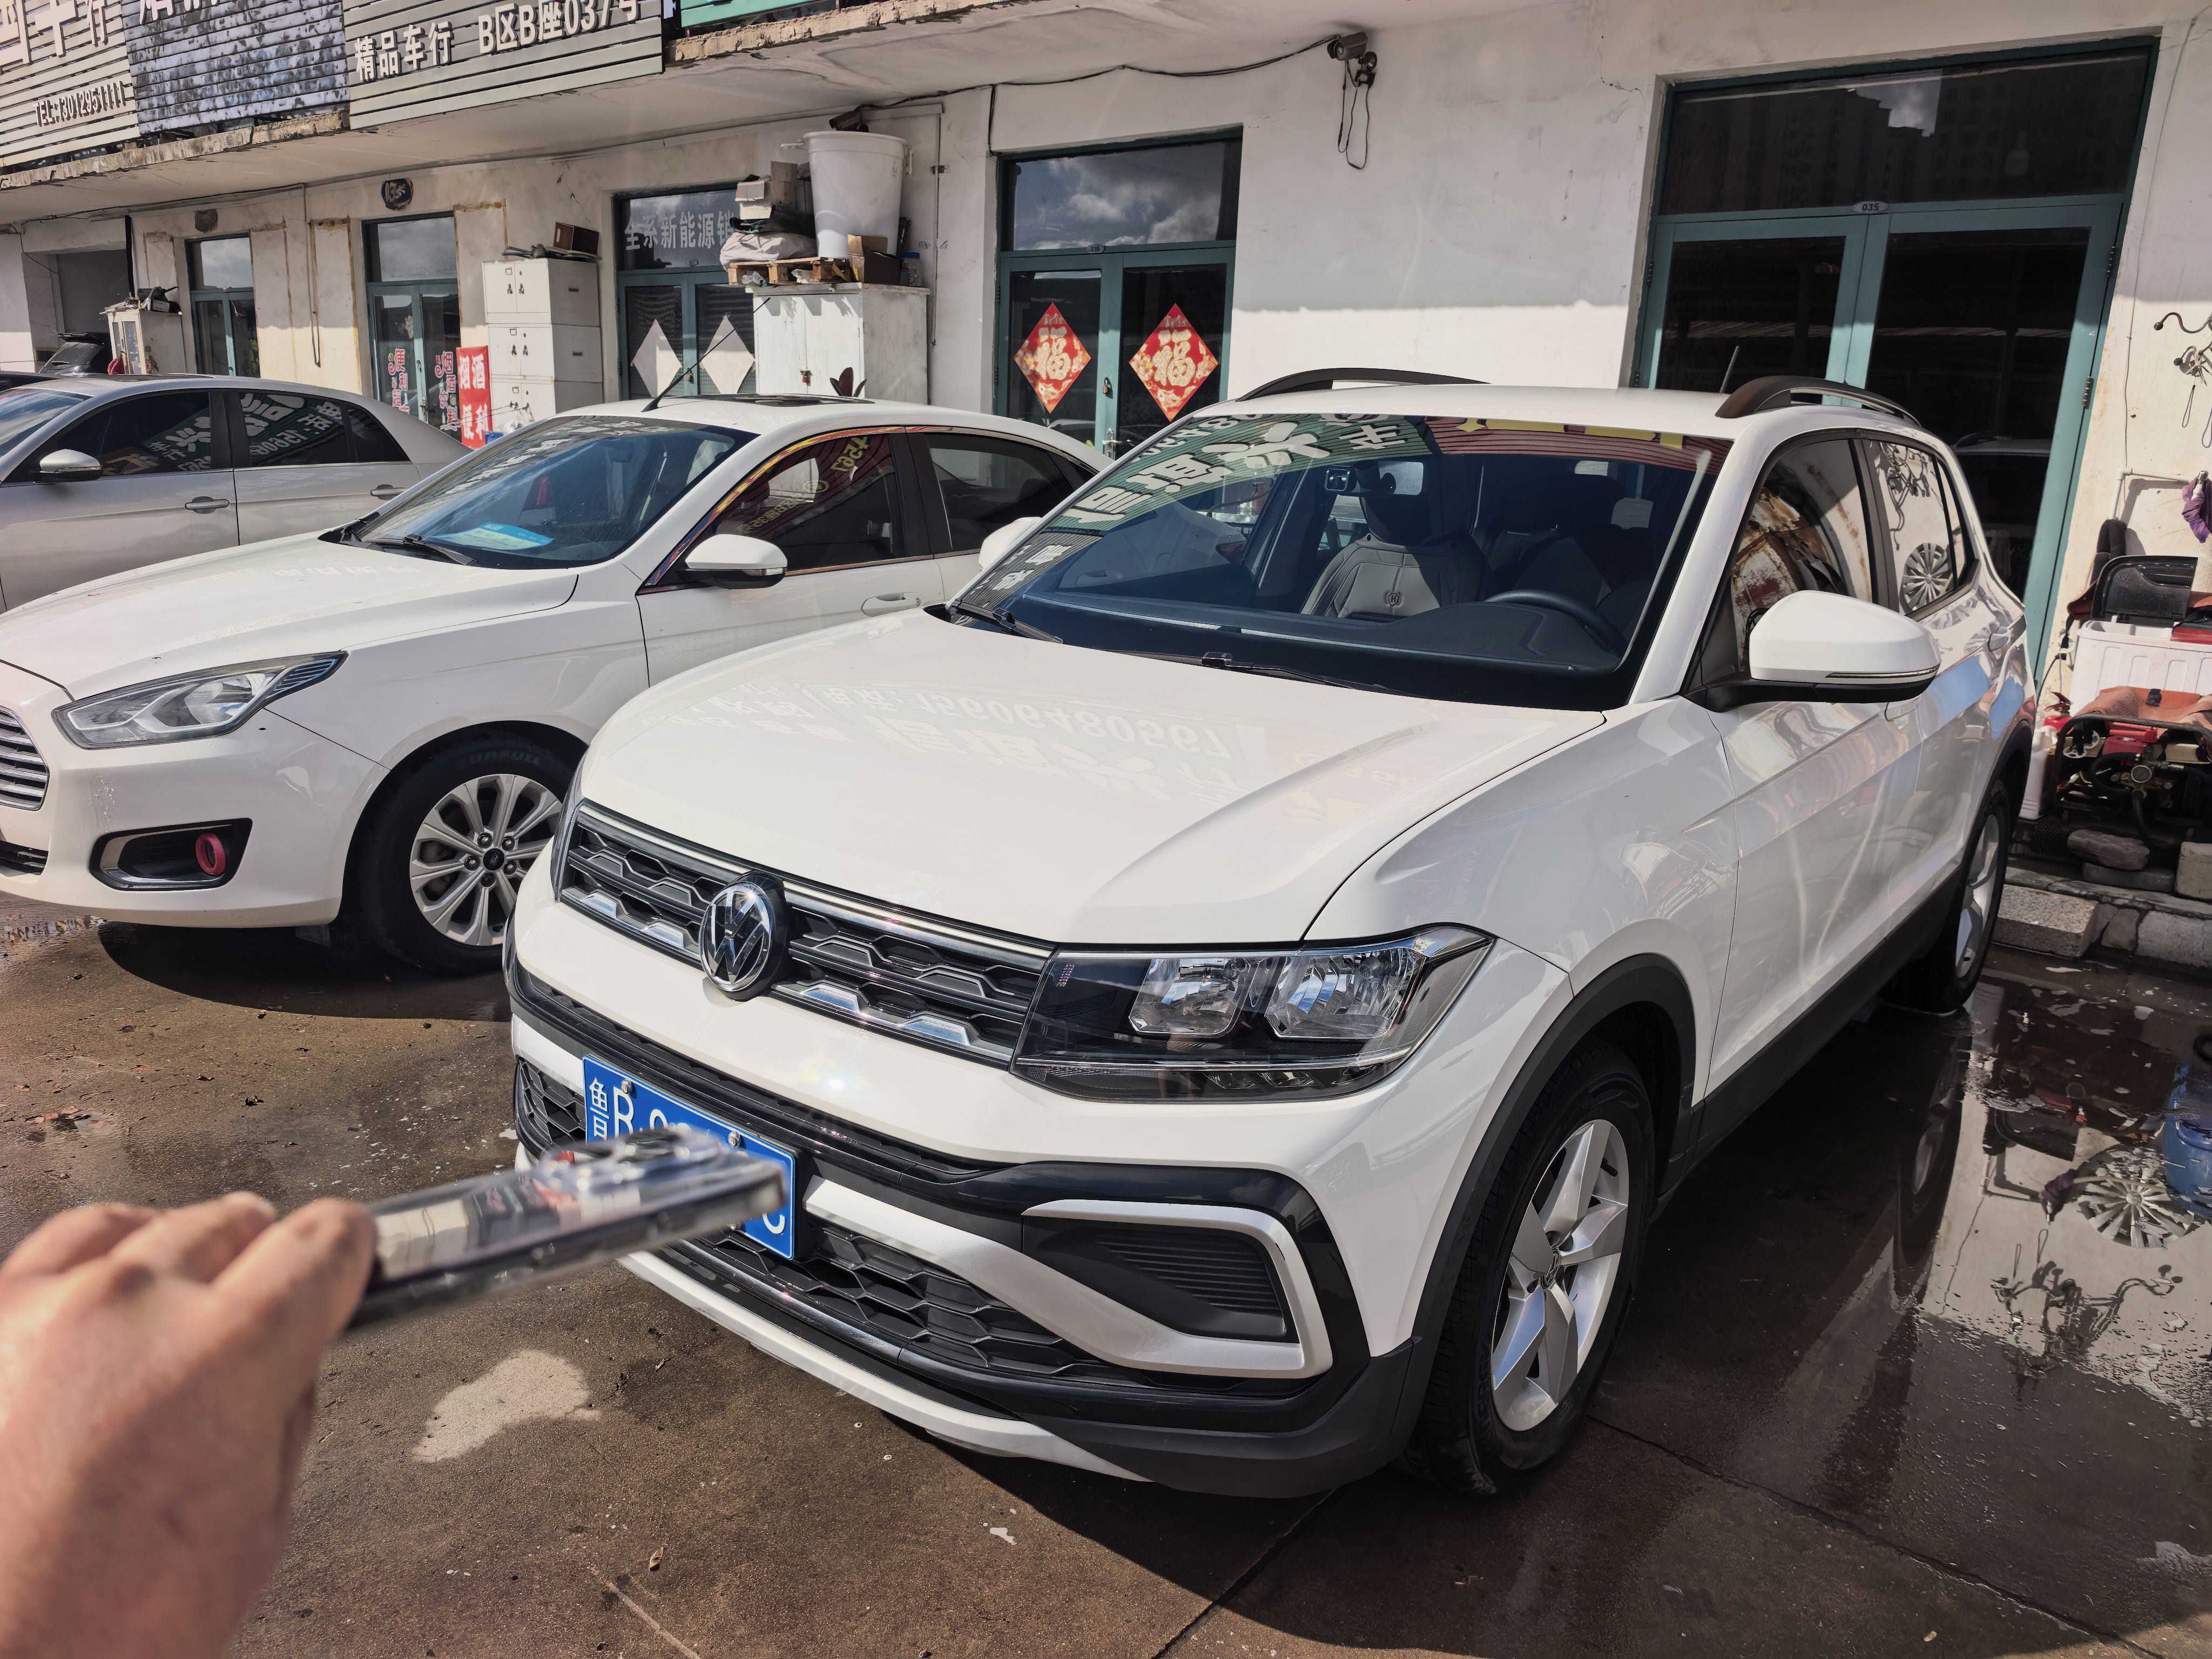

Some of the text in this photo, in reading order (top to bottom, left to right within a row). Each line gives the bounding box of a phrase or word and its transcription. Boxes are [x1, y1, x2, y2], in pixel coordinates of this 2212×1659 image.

[355, 21, 453, 81] 精品车行
[1862, 203, 1879, 211] 035
[1035, 327, 1071, 380] 福
[1152, 329, 1196, 387] 福
